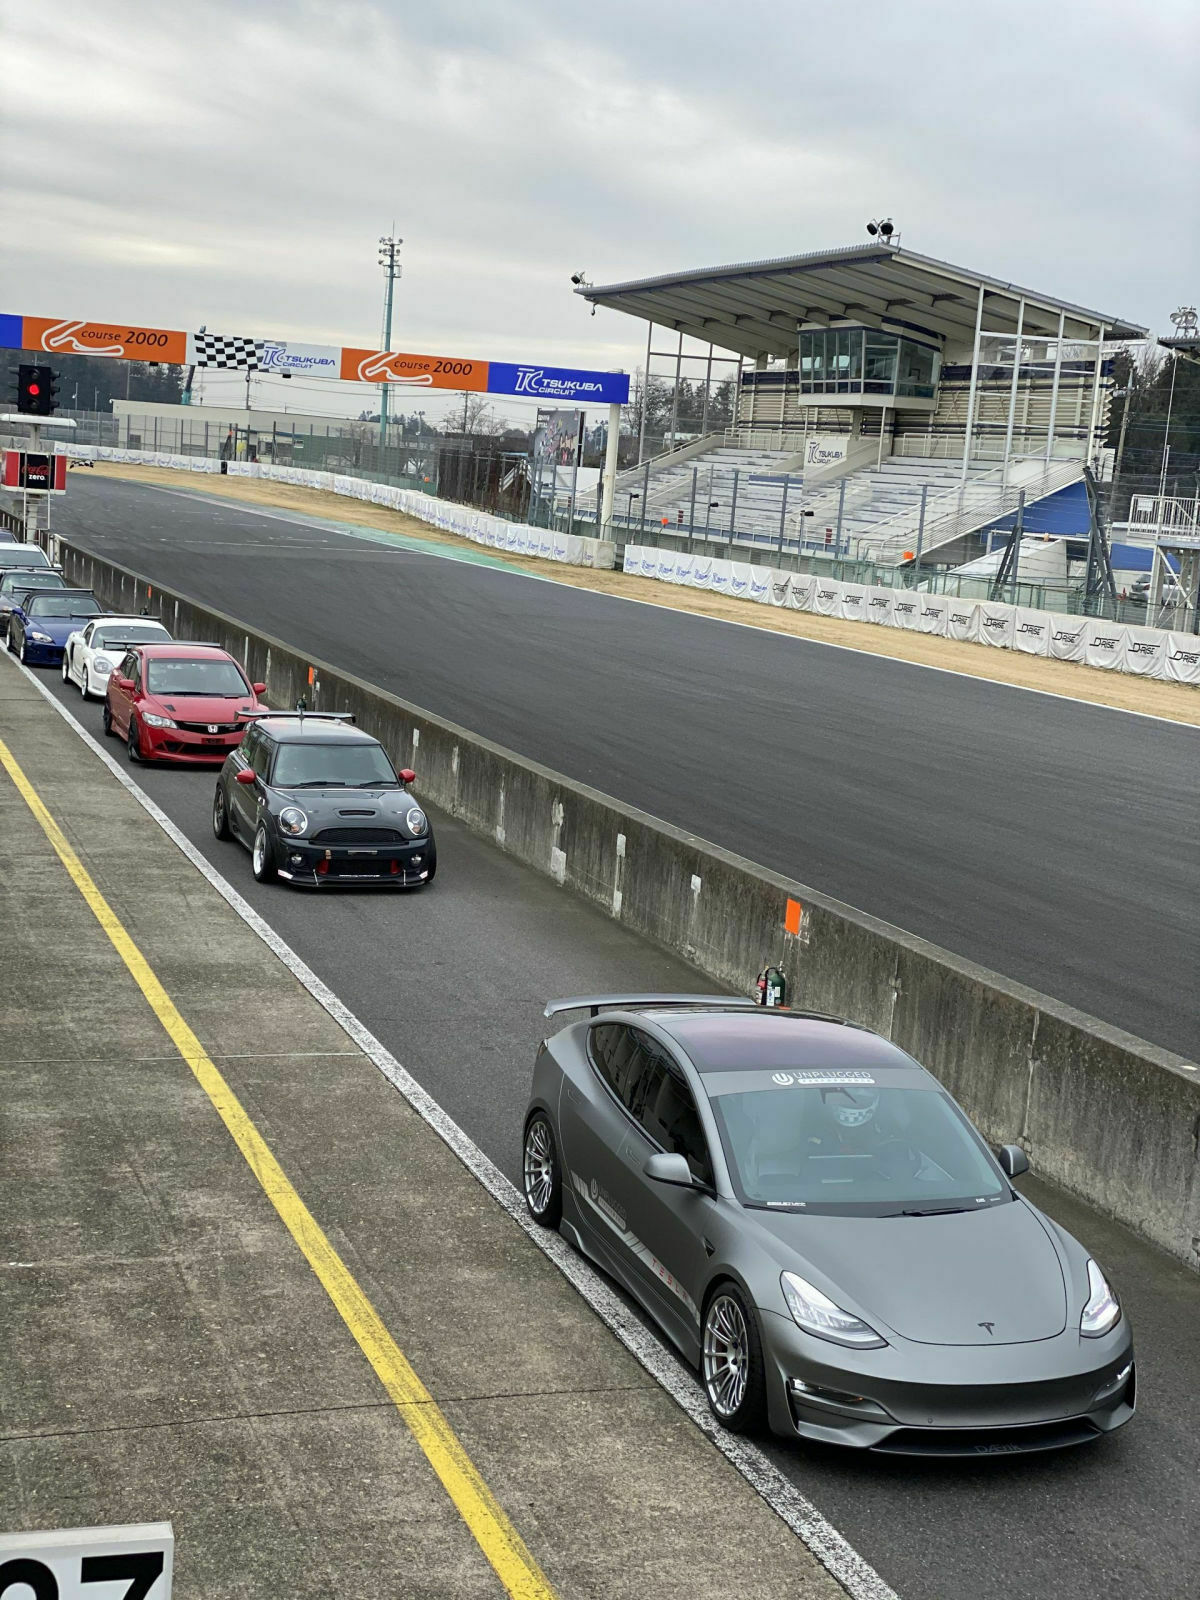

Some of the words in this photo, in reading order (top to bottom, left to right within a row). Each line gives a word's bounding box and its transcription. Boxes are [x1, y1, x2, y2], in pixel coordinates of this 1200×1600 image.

[81, 329, 121, 341] course
[125, 331, 168, 347] 2000
[282, 361, 313, 369] CIRCUIT
[284, 355, 336, 366] TSUKUBA
[394, 359, 430, 371] course
[433, 361, 472, 376] 2000
[541, 378, 602, 392] TSUKUBA
[538, 386, 576, 396] CIRCUIT
[793, 1071, 871, 1079] UNPLUGGED
